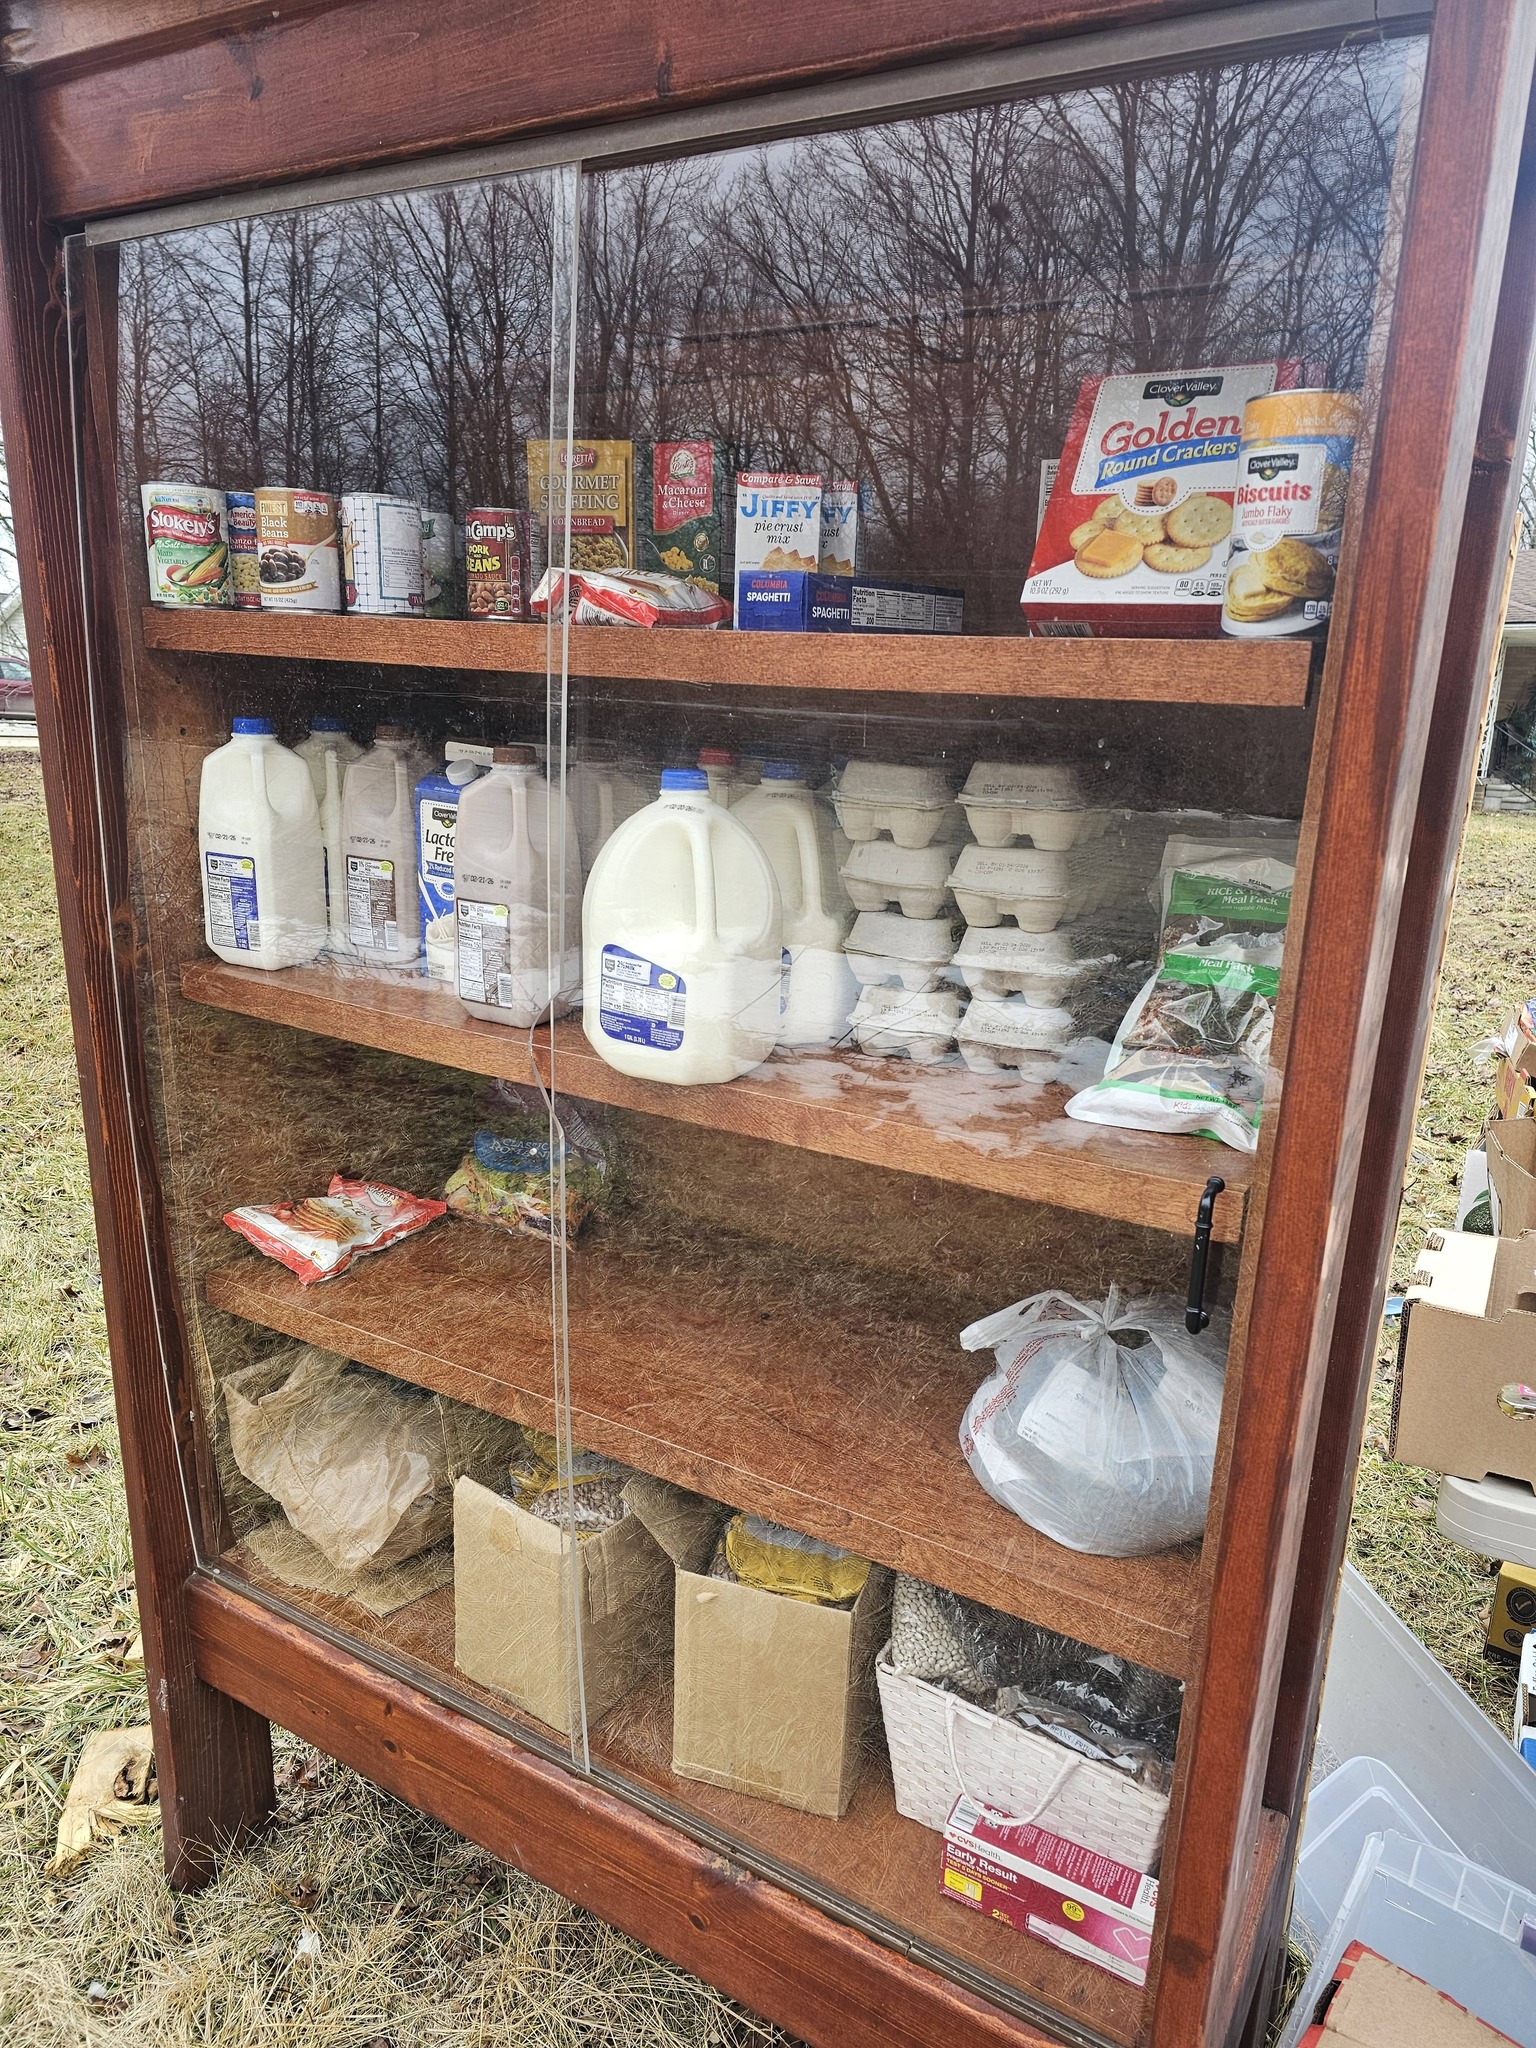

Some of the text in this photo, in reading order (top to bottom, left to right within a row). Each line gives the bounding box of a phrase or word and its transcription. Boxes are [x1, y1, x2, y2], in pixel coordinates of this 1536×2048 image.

[1149, 381, 1216, 395] Clover Valley
[1101, 407, 1242, 456] Golden
[1101, 441, 1237, 480] Round Crackers
[1250, 456, 1294, 470] Clover Valley
[540, 475, 619, 491] GOURMET
[742, 473, 820, 486] Compare & Save!
[658, 484, 708, 496] Macaroni
[832, 481, 855, 491] Save!
[1237, 480, 1312, 506] Biscuits
[262, 502, 286, 514] FINEST
[541, 494, 619, 510] STUFFING
[669, 499, 706, 508] Cheese
[230, 510, 256, 518] America
[1242, 505, 1293, 520] Jumbo Flaky
[151, 509, 216, 537] Stokely's
[261, 517, 288, 528] Black
[552, 518, 605, 527] CONBREAD
[754, 520, 804, 534] pie crust
[261, 528, 289, 539] Beans
[767, 533, 791, 544] mix
[469, 545, 490, 555] PORK
[751, 580, 788, 589] COLUMBIA
[746, 592, 791, 602] SPAGHETTI
[853, 588, 876, 597] Nutrition
[853, 596, 867, 604] Facts
[812, 607, 850, 619] SPAGHETTI
[433, 809, 447, 819] Clover
[434, 864, 453, 874] Reduced
[1207, 887, 1233, 896] RICE
[1222, 895, 1278, 906] Meal Pack
[1199, 959, 1256, 974] Meal Pack
[1173, 1101, 1192, 1110] Kids
[491, 1140, 550, 1159] ROMAN
[502, 1138, 549, 1151] CLASSIC
[1487, 1650, 1501, 1663] PRE
[1050, 1724, 1072, 1741] BEANS
[946, 1842, 977, 1865] Early
[979, 1860, 1018, 1884] Result
[946, 1852, 988, 1876] Pregnancy Test
[946, 1858, 961, 1869] TEST
[966, 1867, 982, 1879] DAYS
[1141, 1878, 1155, 1904] Health
[992, 1908, 1000, 1919] 2
